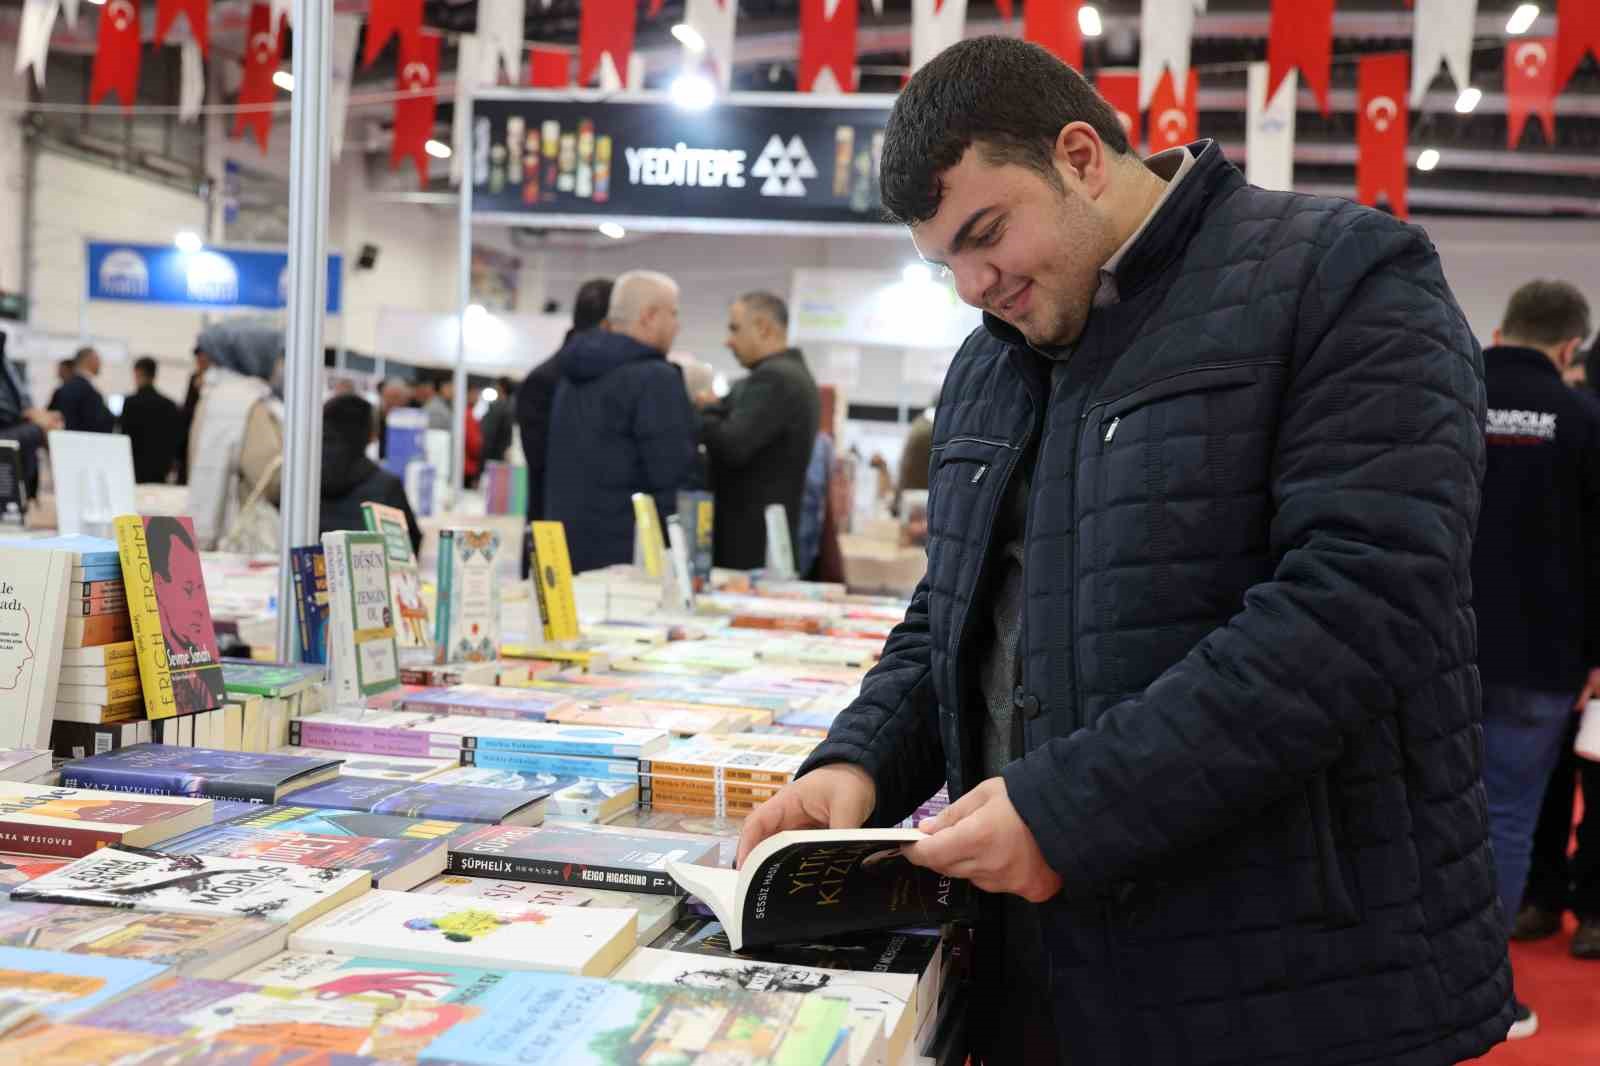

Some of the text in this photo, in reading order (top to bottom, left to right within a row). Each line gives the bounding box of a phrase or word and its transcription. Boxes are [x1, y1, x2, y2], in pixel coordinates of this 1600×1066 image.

[152, 633, 175, 705] ERICH
[23, 834, 73, 847] WESTOVER
[461, 857, 503, 873] ŞÜPHELİ
[504, 862, 512, 873] X
[582, 869, 647, 886] KEIGO HIGASHINO
